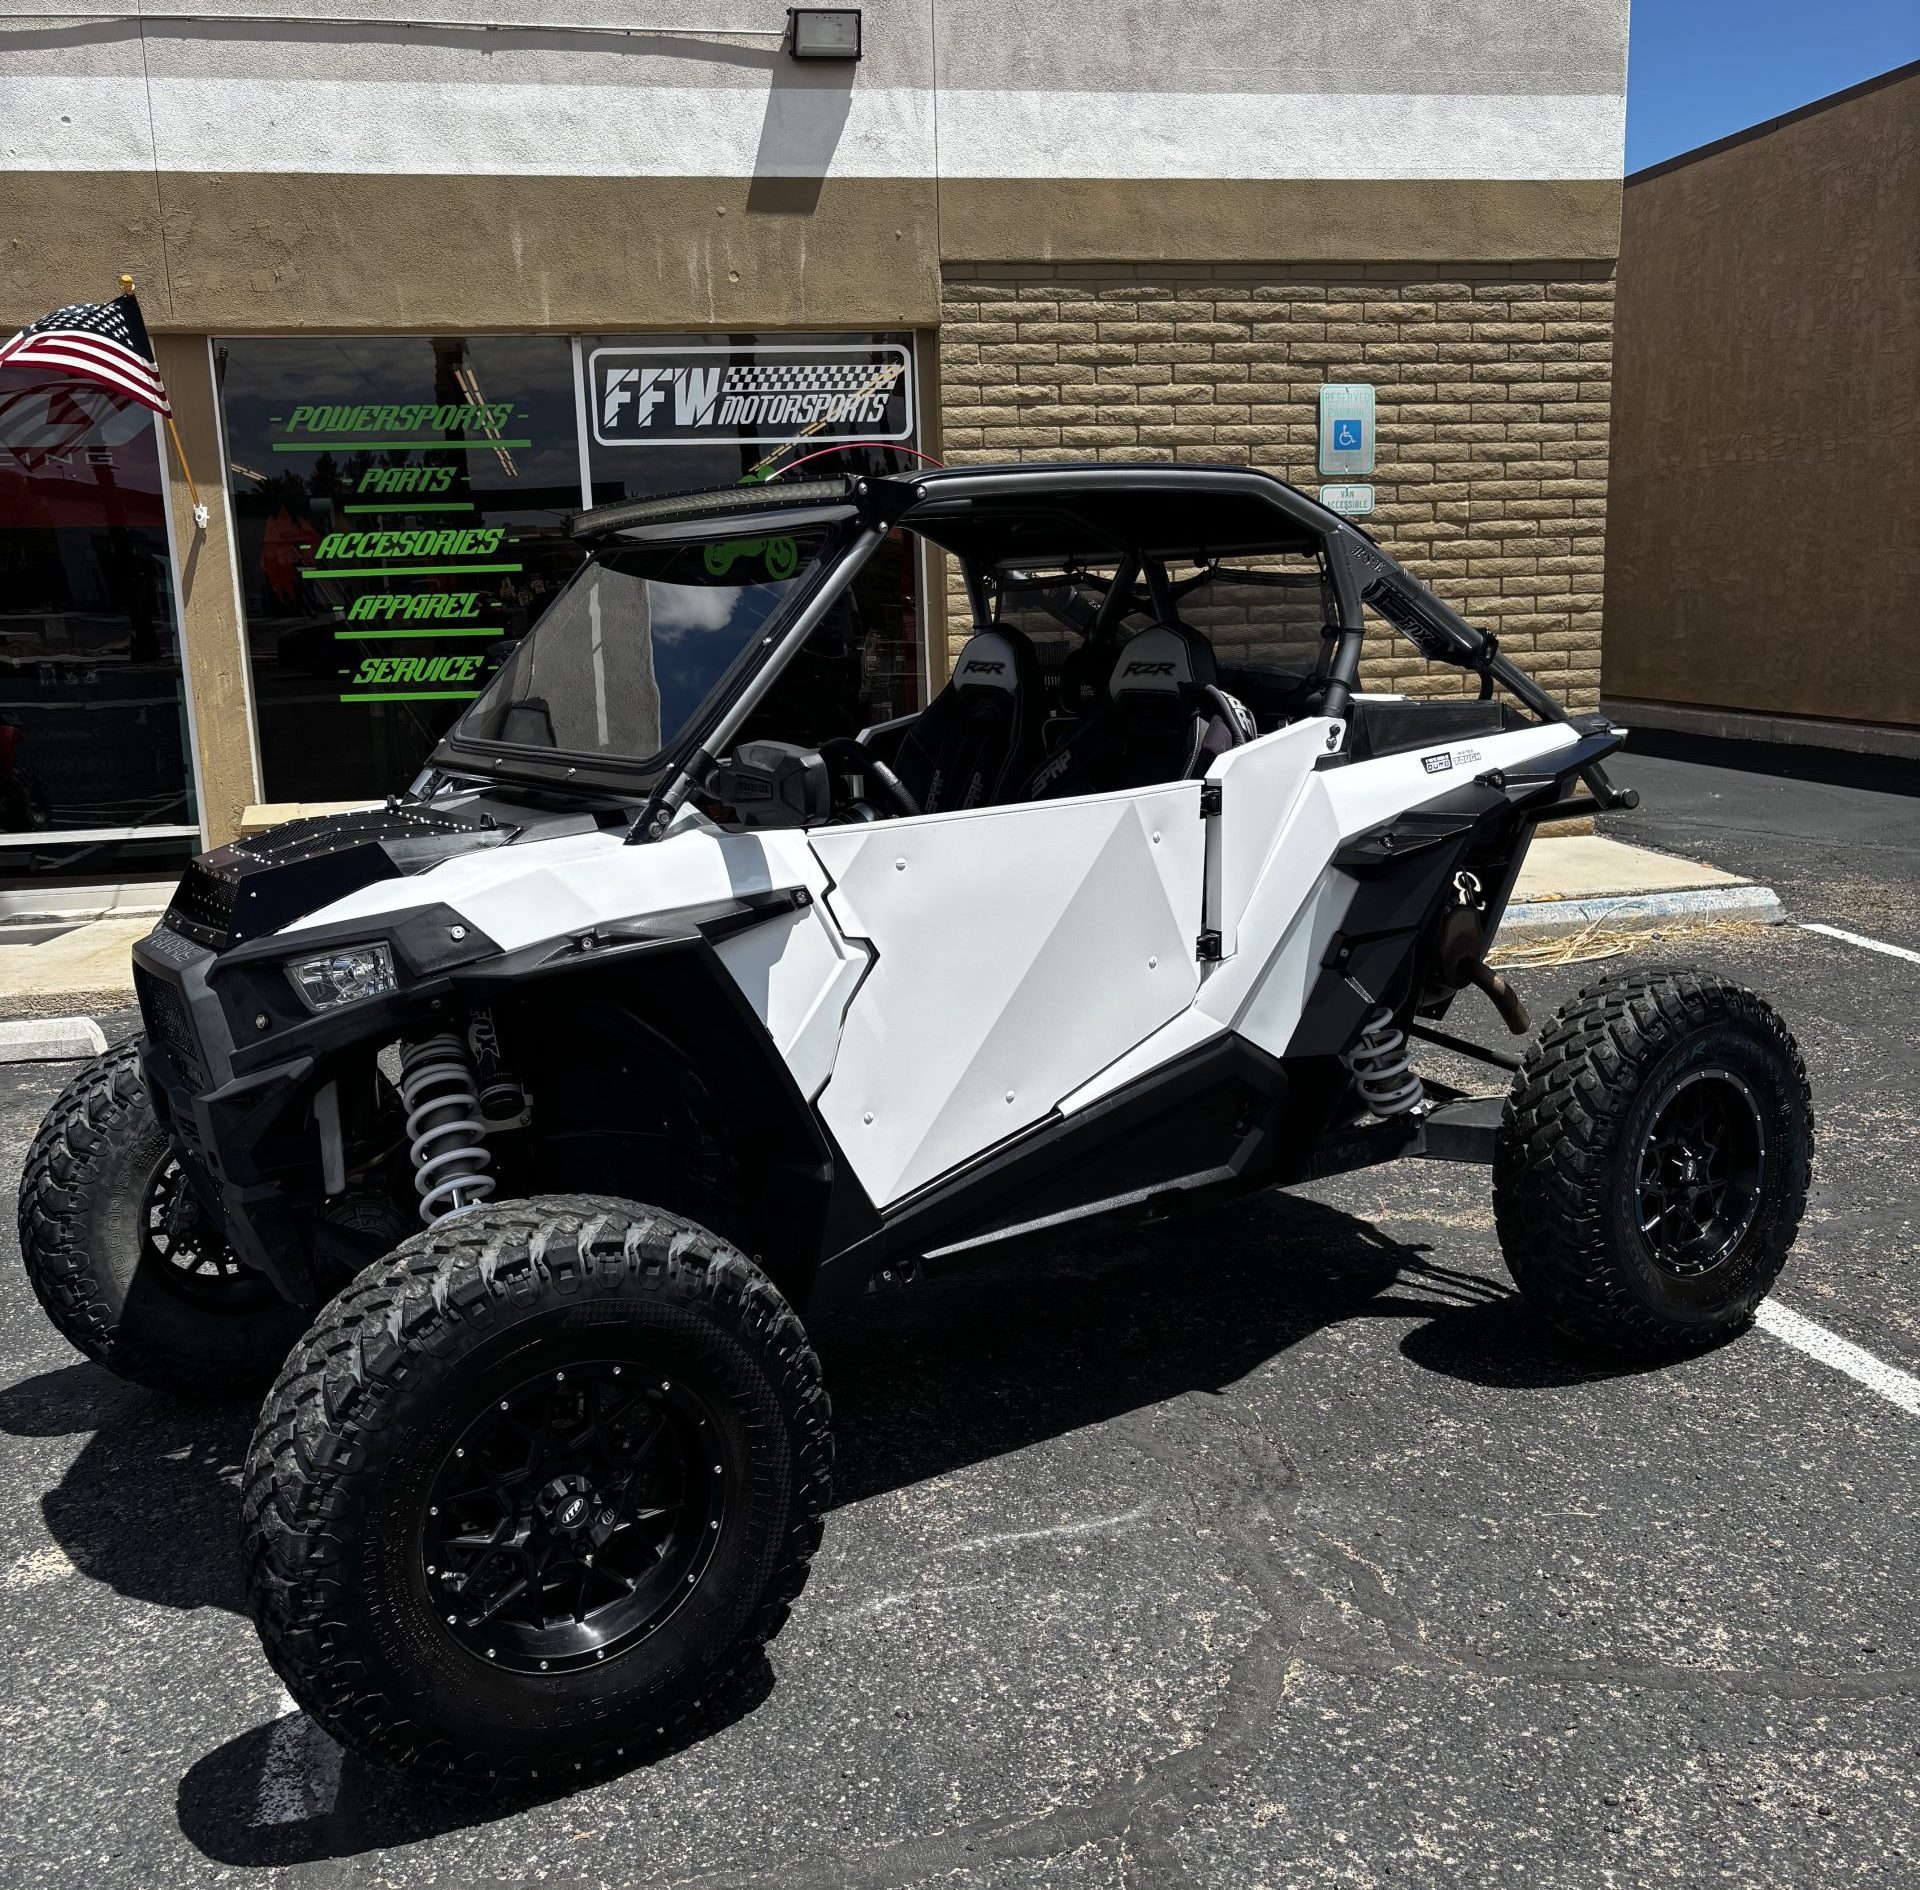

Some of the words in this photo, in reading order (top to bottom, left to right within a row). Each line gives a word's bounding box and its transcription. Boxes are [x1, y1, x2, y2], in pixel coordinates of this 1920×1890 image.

[603, 367, 721, 429] FFW
[717, 393, 890, 425] MOTORSPORTS
[286, 403, 513, 433] POWERSPORTS
[357, 467, 456, 492] PARTS
[1327, 500, 1368, 509] ACCESSIBLE
[1340, 490, 1355, 499] VAN
[315, 528, 505, 559] ACCESORIES
[347, 593, 480, 620] APPAREL
[352, 655, 484, 684] SERVICE
[962, 659, 1006, 676] RZR
[1122, 661, 1177, 677] RZR
[564, 1500, 582, 1522] ITP
